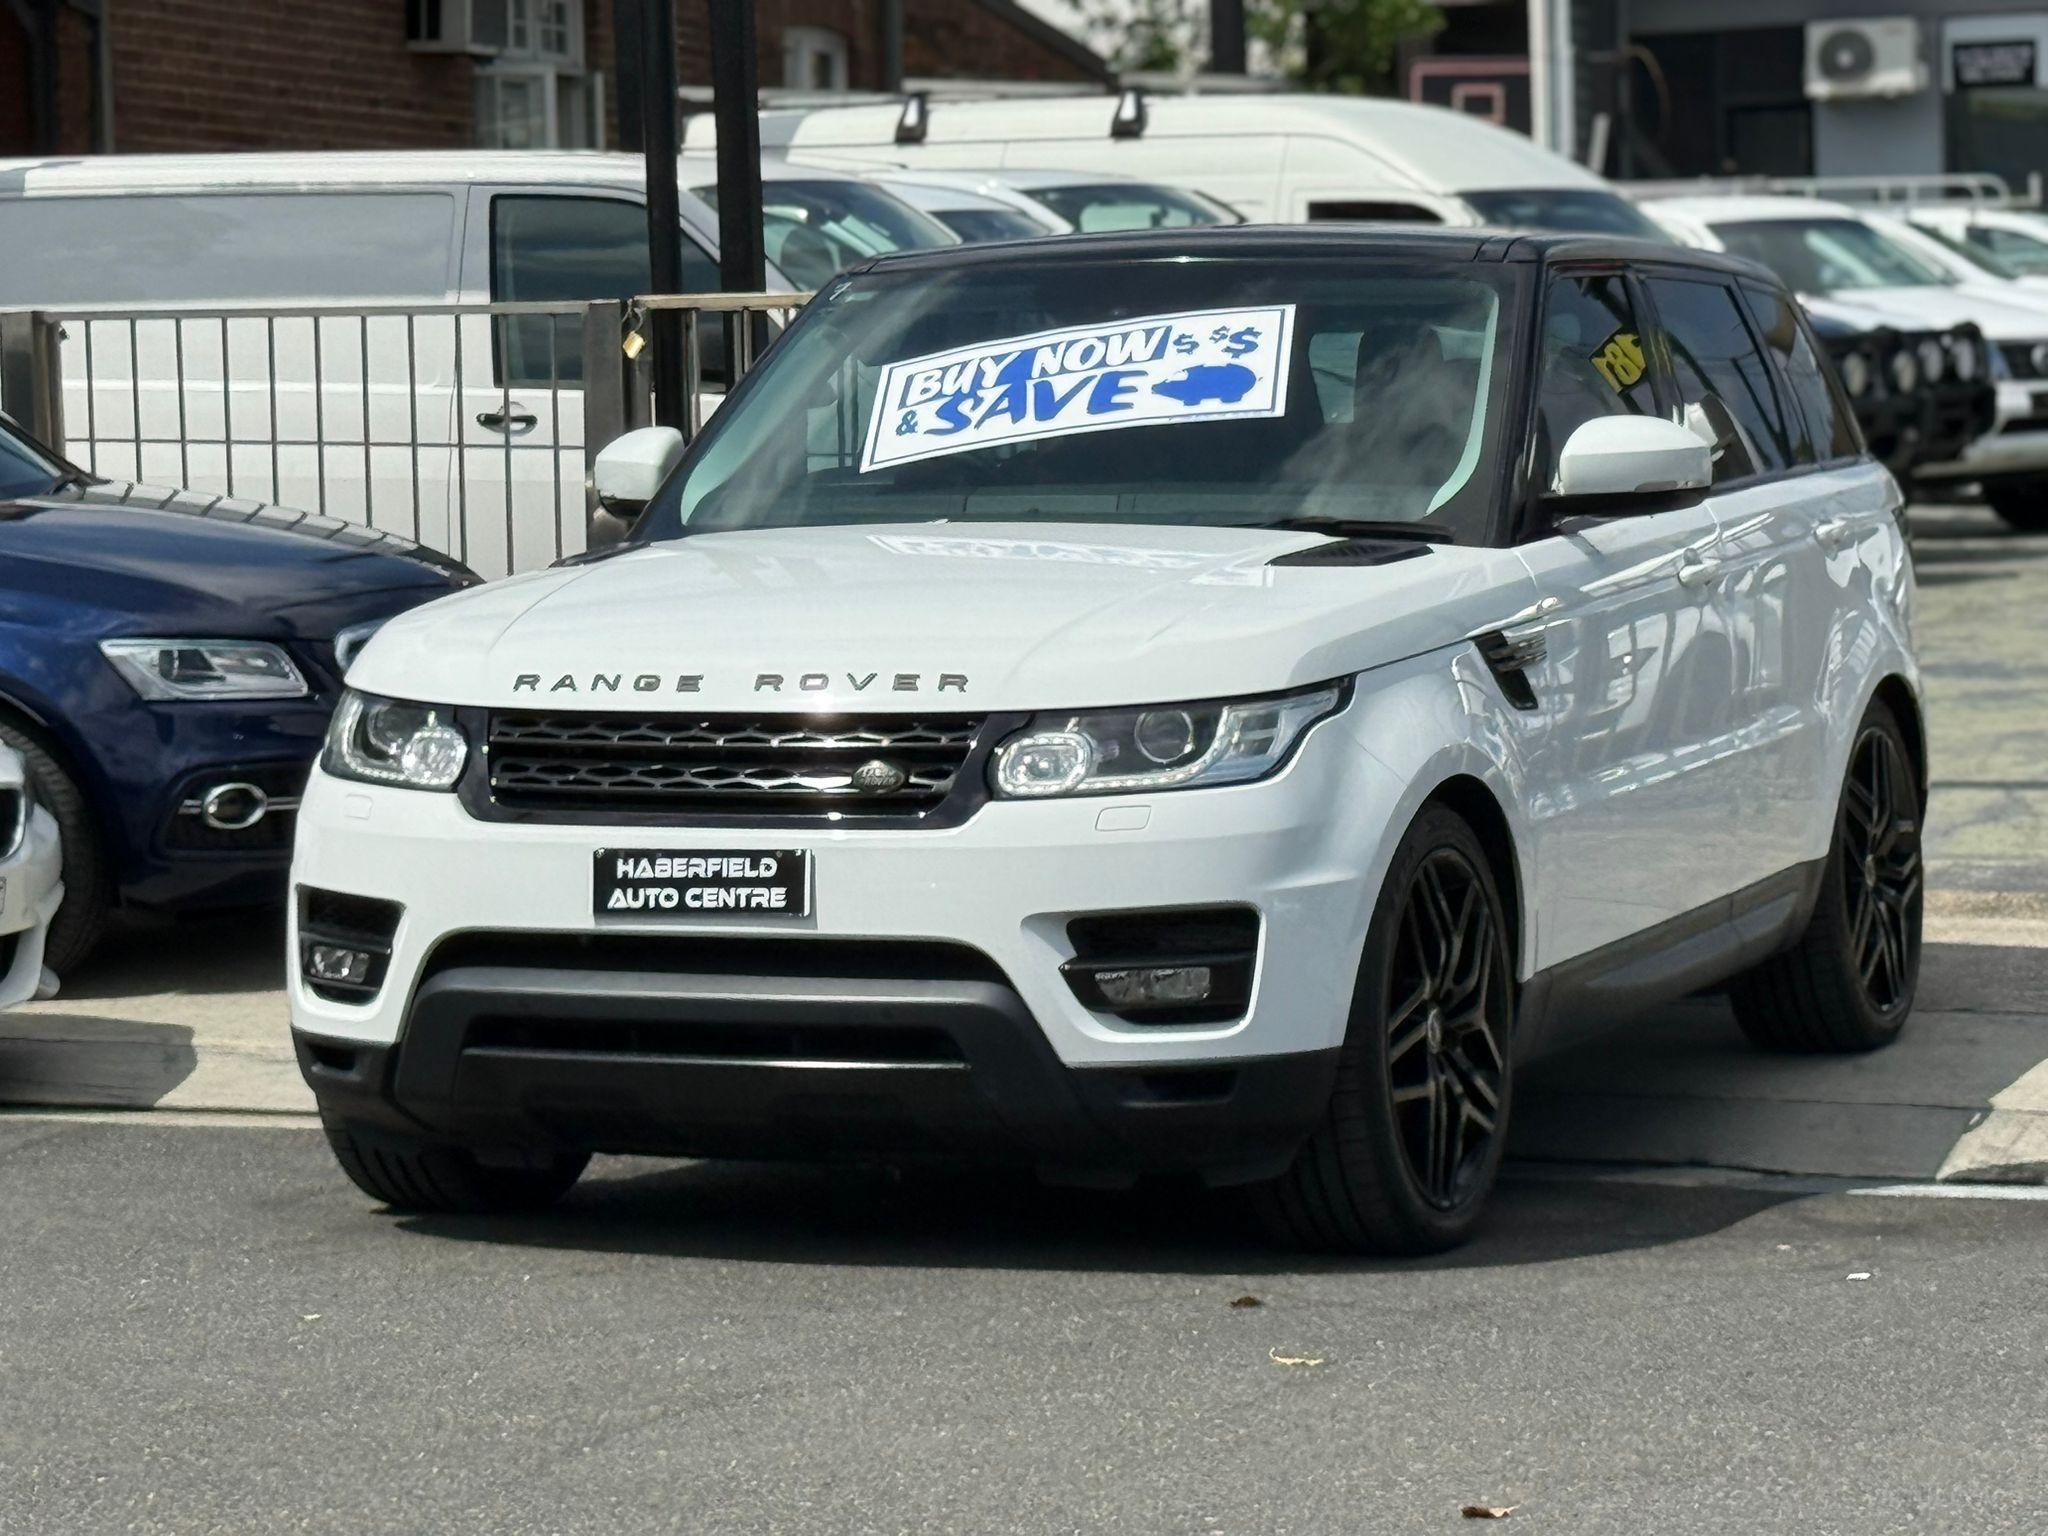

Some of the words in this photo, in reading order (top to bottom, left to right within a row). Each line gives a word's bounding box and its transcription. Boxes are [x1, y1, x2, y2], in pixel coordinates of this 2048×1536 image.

[905, 353, 1022, 407] BUY
[1031, 328, 1162, 378] NOW
[922, 370, 1150, 436] SAVE
[513, 674, 704, 692] RANGE
[755, 674, 969, 692] ROVER
[616, 857, 778, 878] HABERFIELD
[607, 887, 679, 909] AUTO
[685, 887, 788, 908] CENTRE
